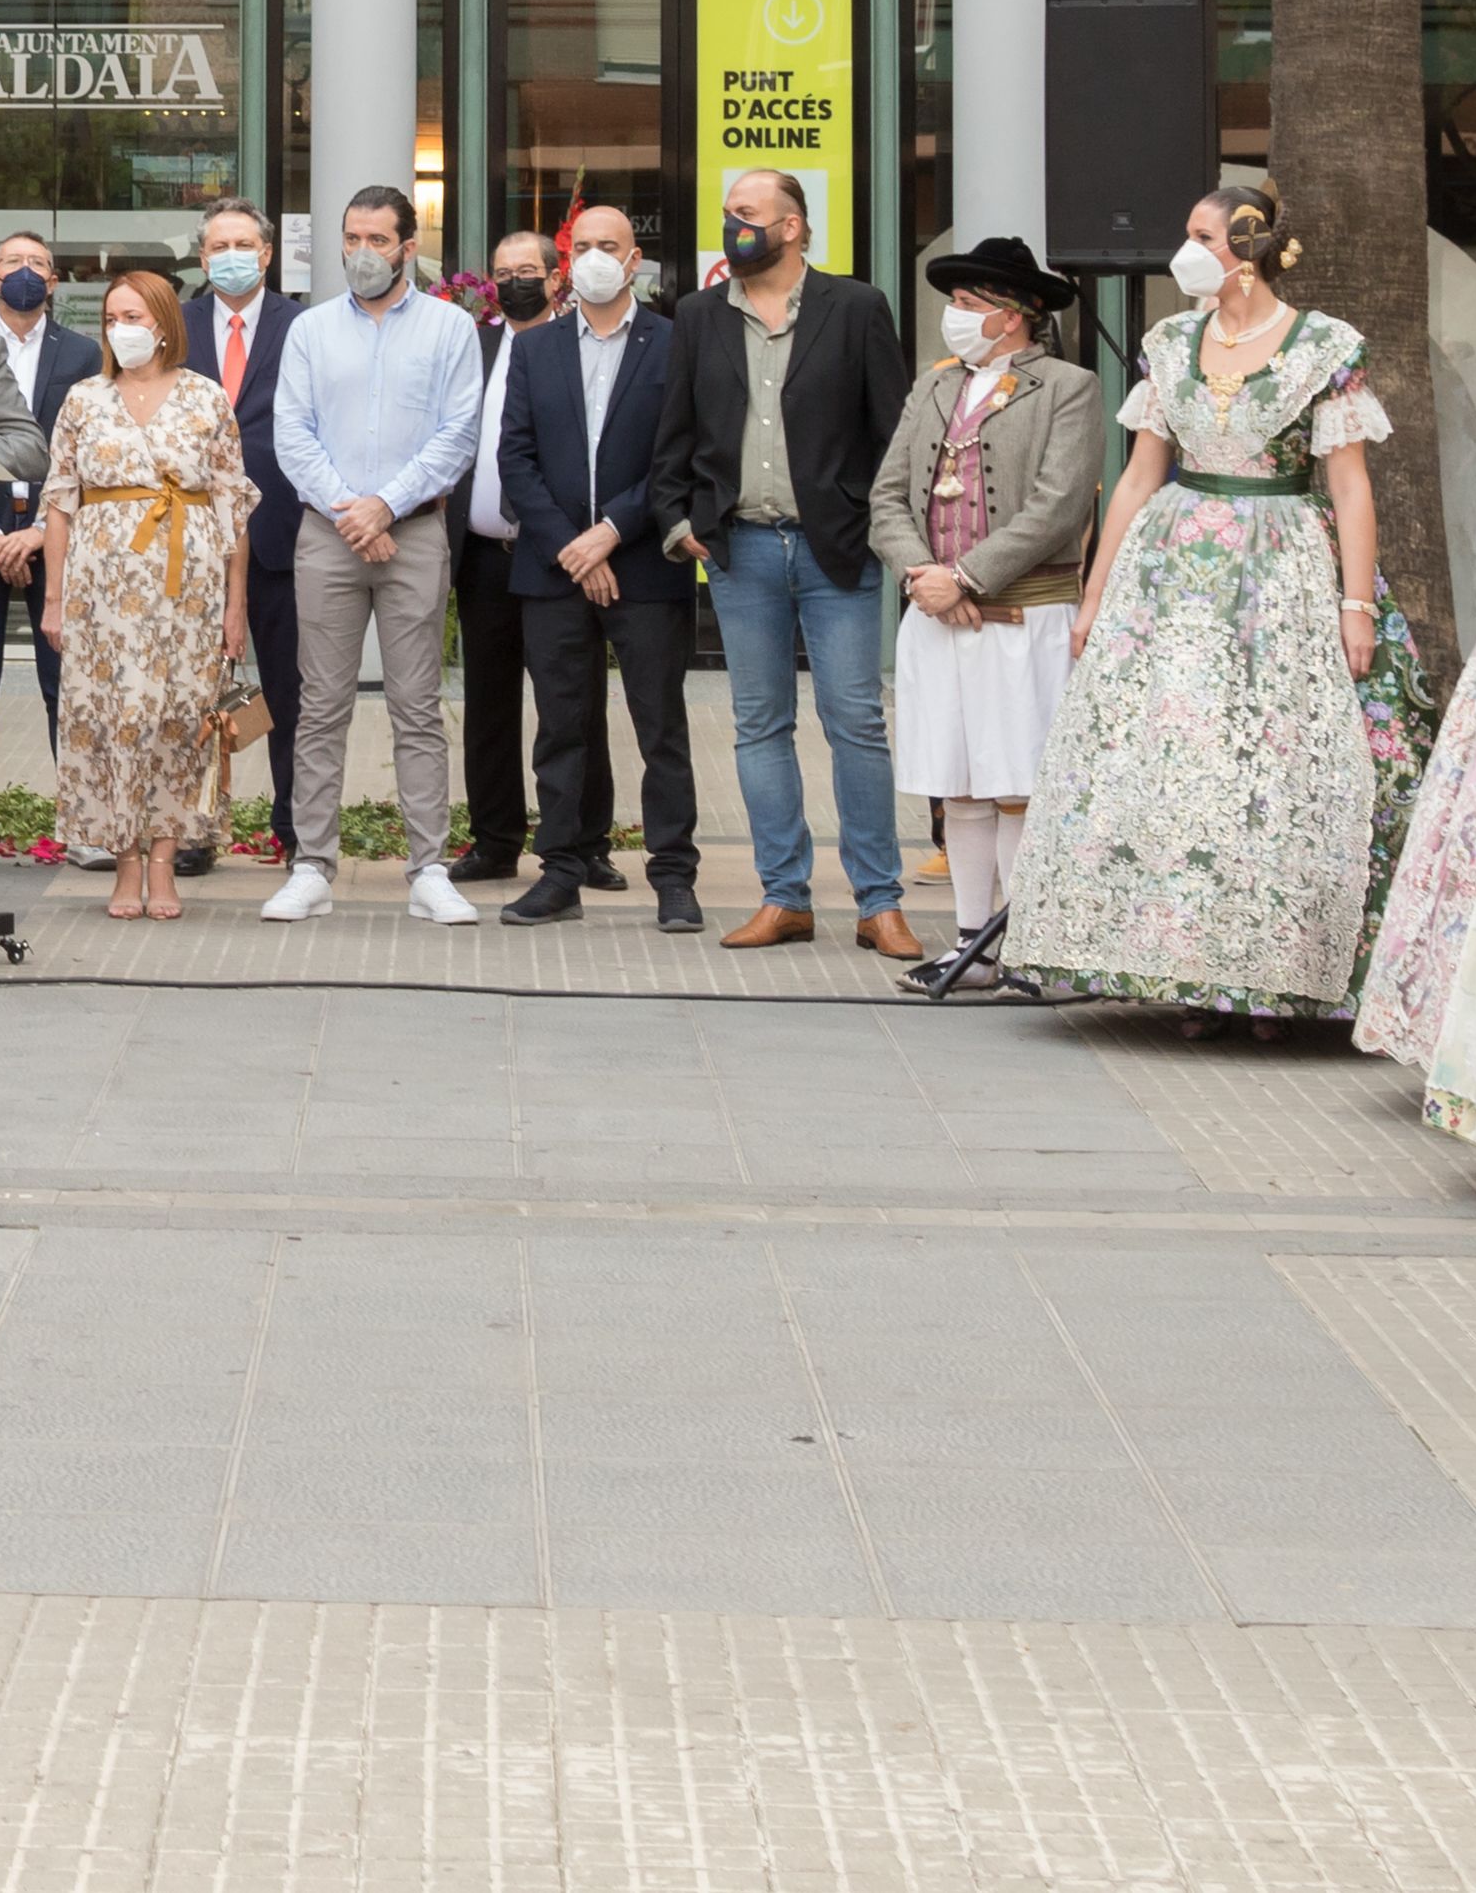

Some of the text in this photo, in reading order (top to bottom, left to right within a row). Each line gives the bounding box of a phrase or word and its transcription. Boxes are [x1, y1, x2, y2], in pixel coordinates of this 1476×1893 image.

[723, 71, 794, 92] PUNT
[723, 93, 833, 120] D'ACCÉS
[722, 127, 821, 149] ONLINE
